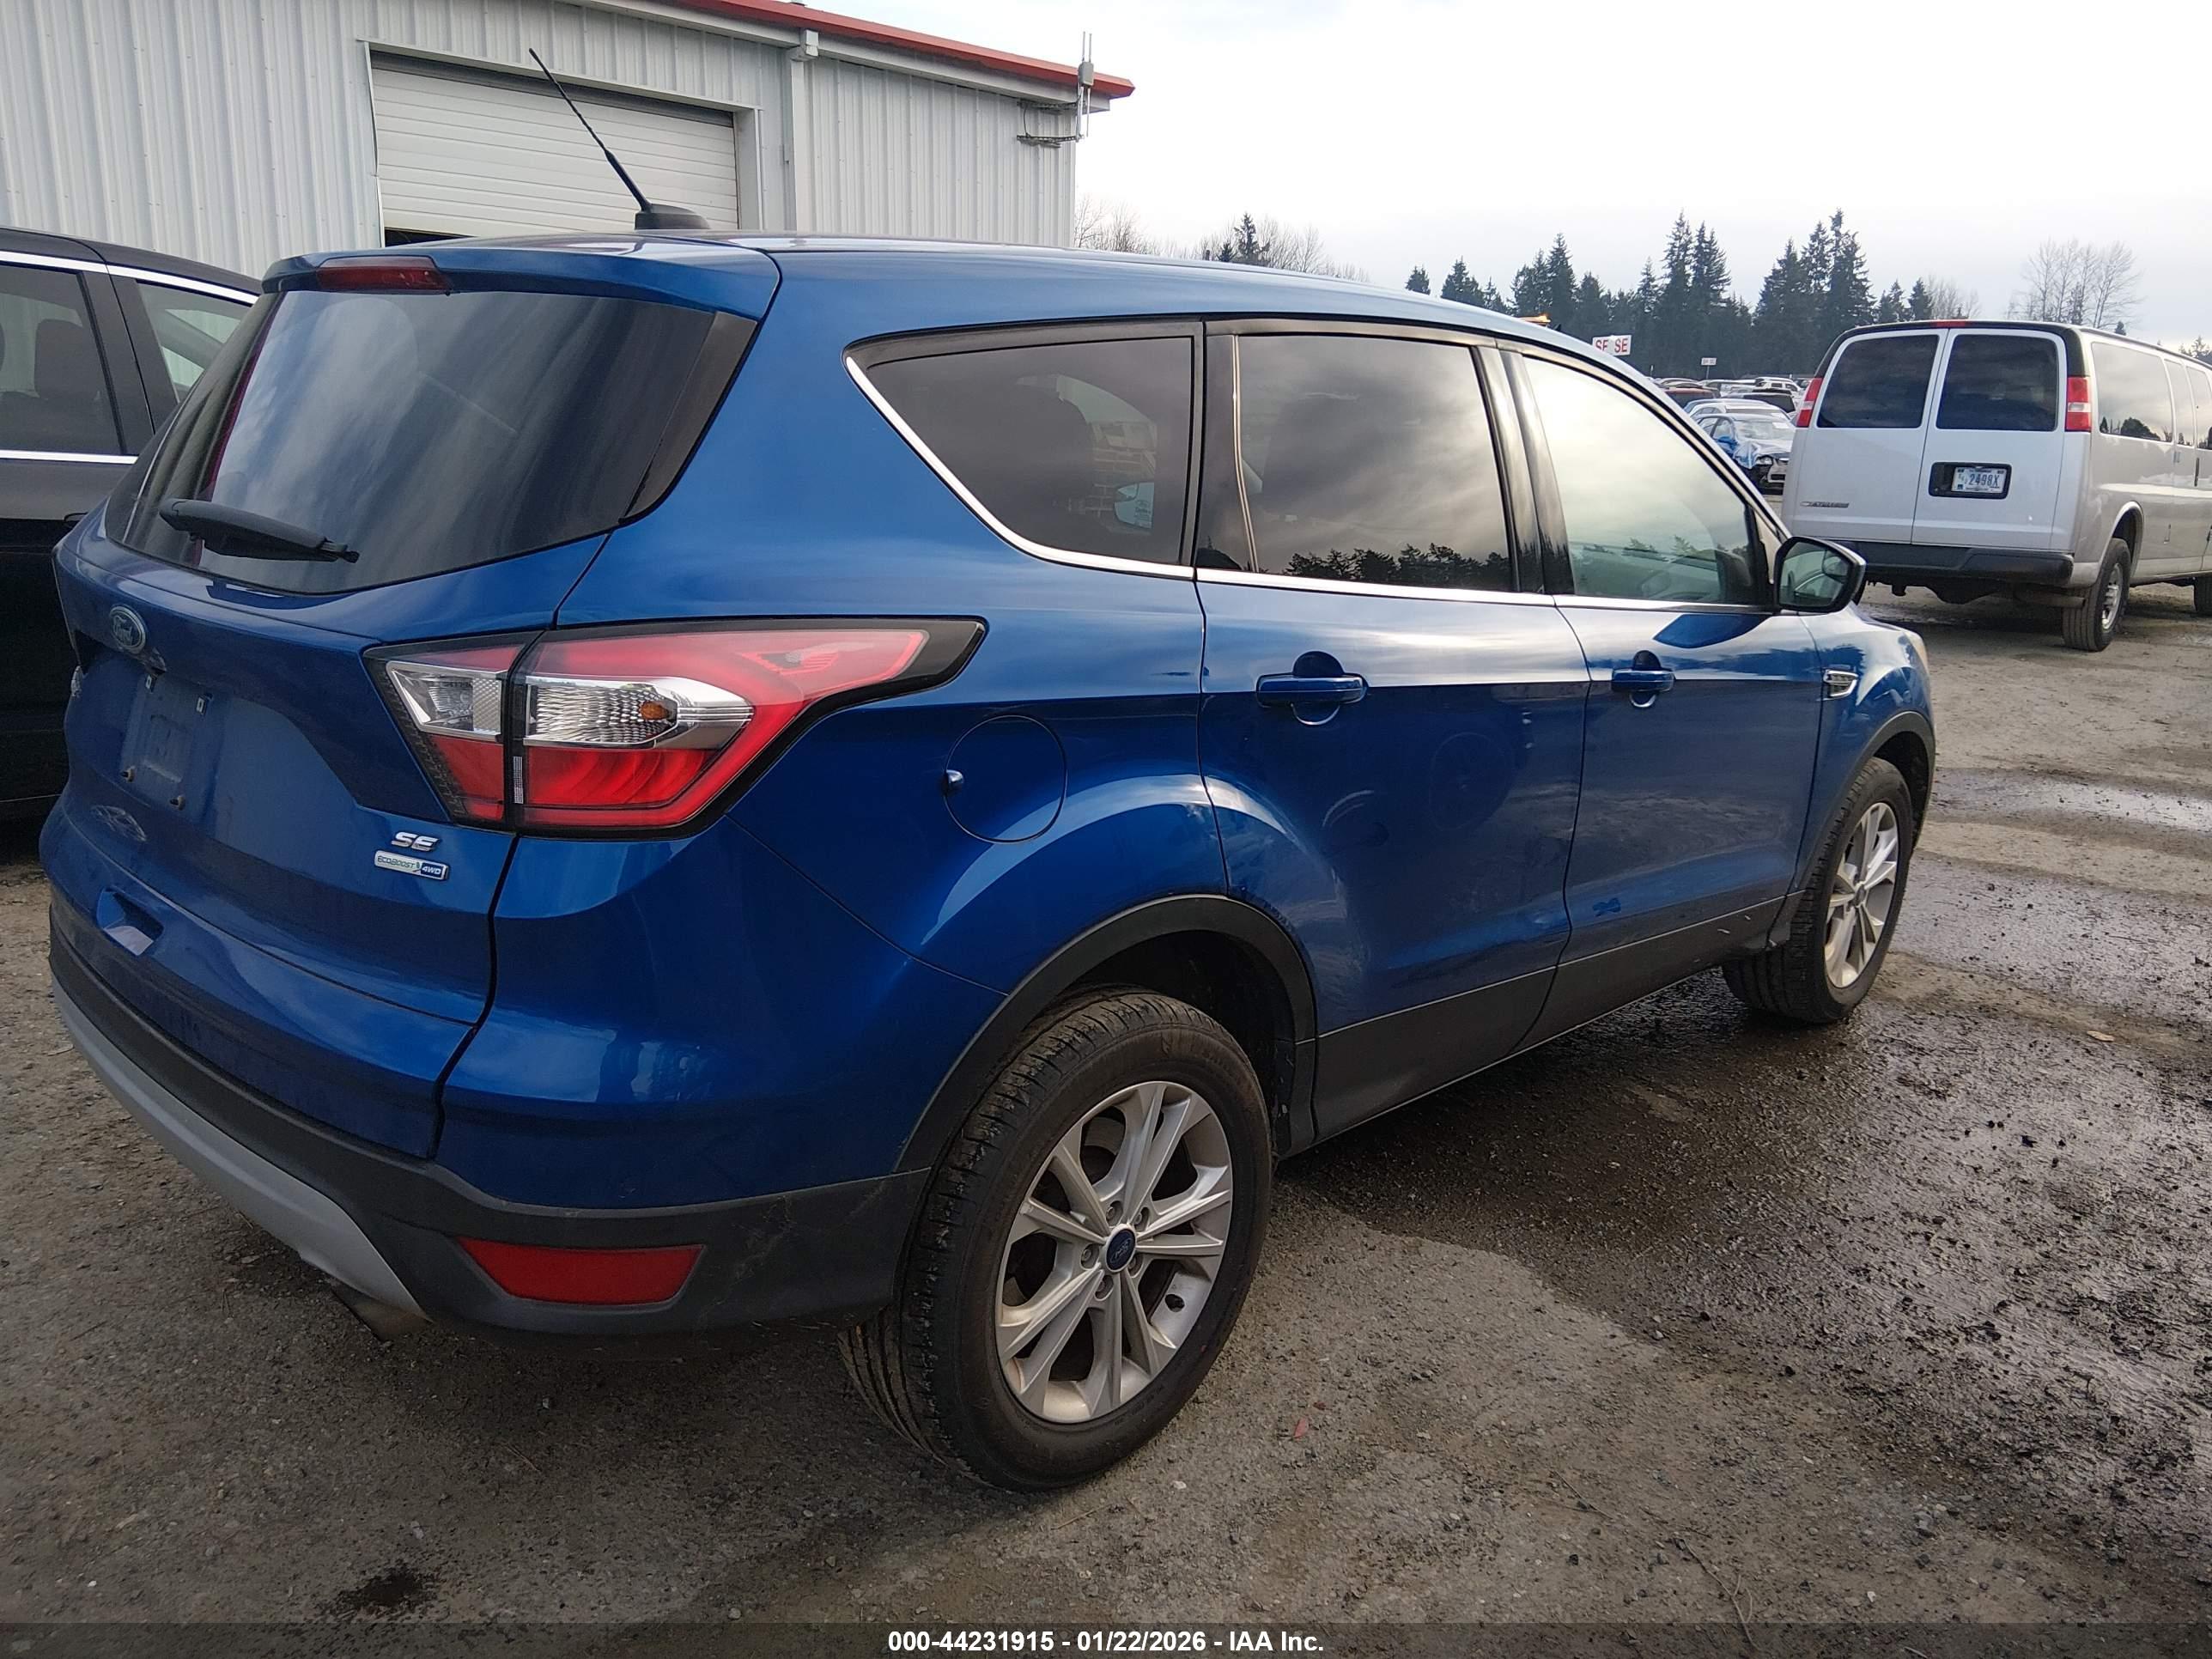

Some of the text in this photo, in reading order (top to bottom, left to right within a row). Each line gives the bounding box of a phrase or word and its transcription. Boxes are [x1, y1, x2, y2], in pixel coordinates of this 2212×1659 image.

[1613, 337, 1628, 353] SE
[391, 831, 440, 852] SE
[422, 866, 441, 875] 4WD
